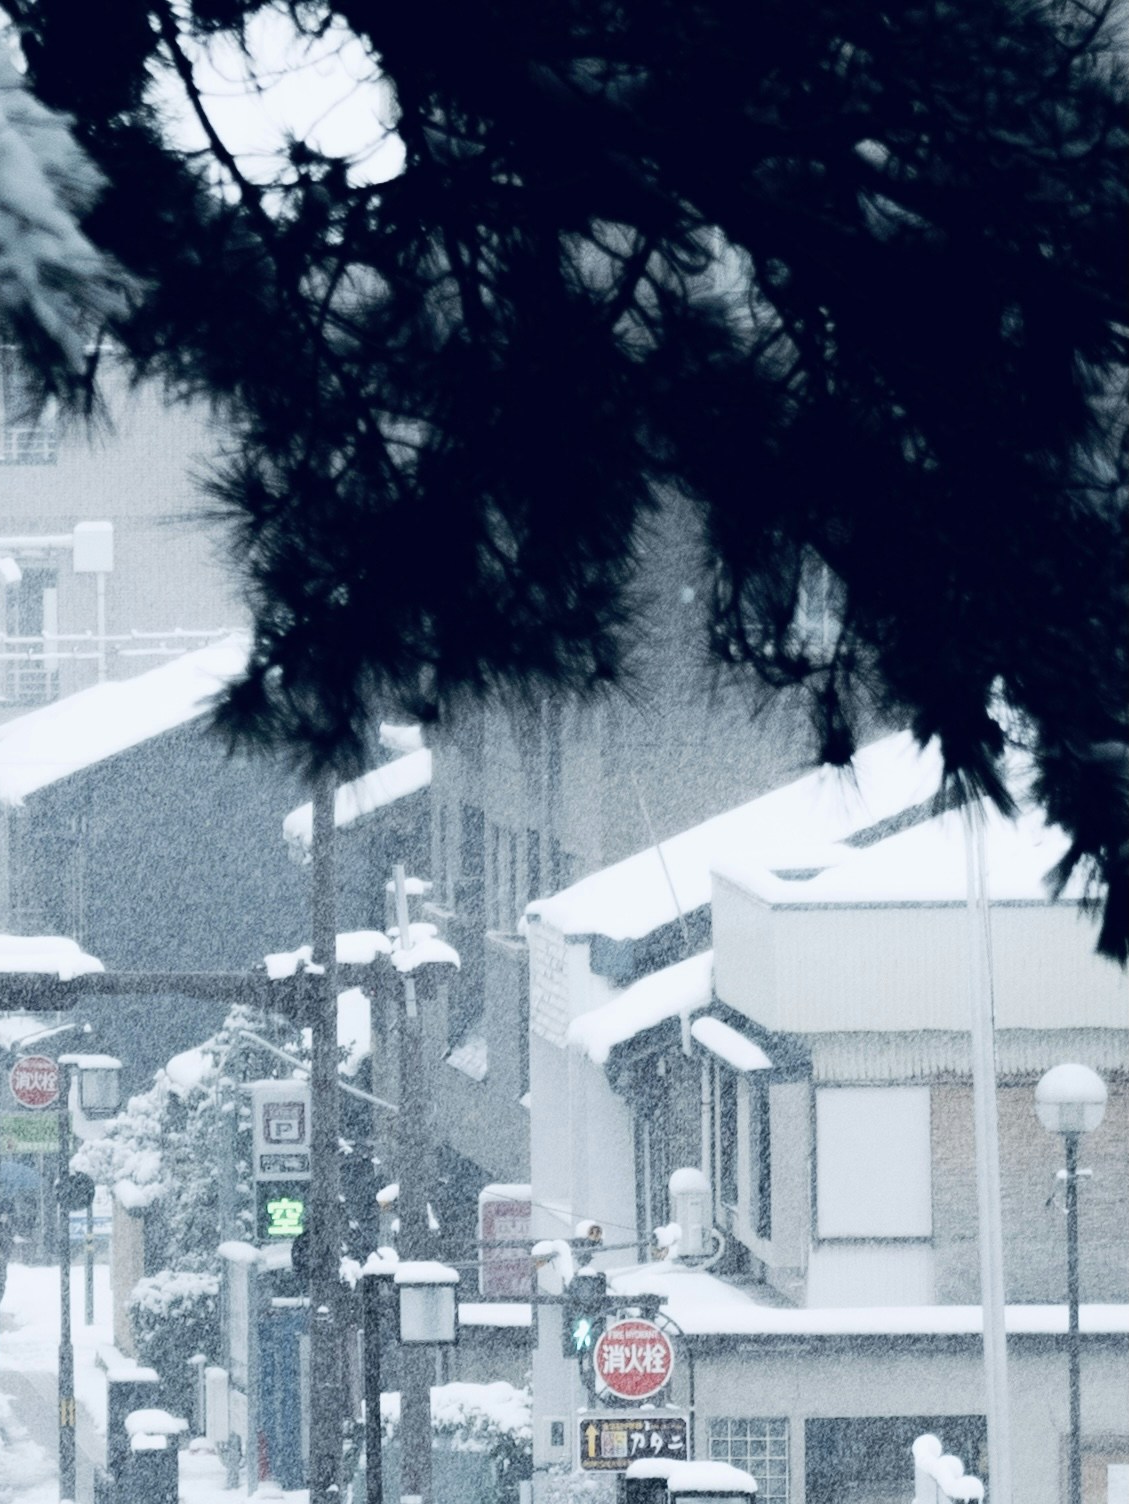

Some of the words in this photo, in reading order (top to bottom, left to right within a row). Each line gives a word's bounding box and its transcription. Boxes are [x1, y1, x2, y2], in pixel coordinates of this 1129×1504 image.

[15, 1071, 58, 1091] 消火栓
[267, 1198, 304, 1234] 空
[603, 1344, 666, 1374] 消火栓
